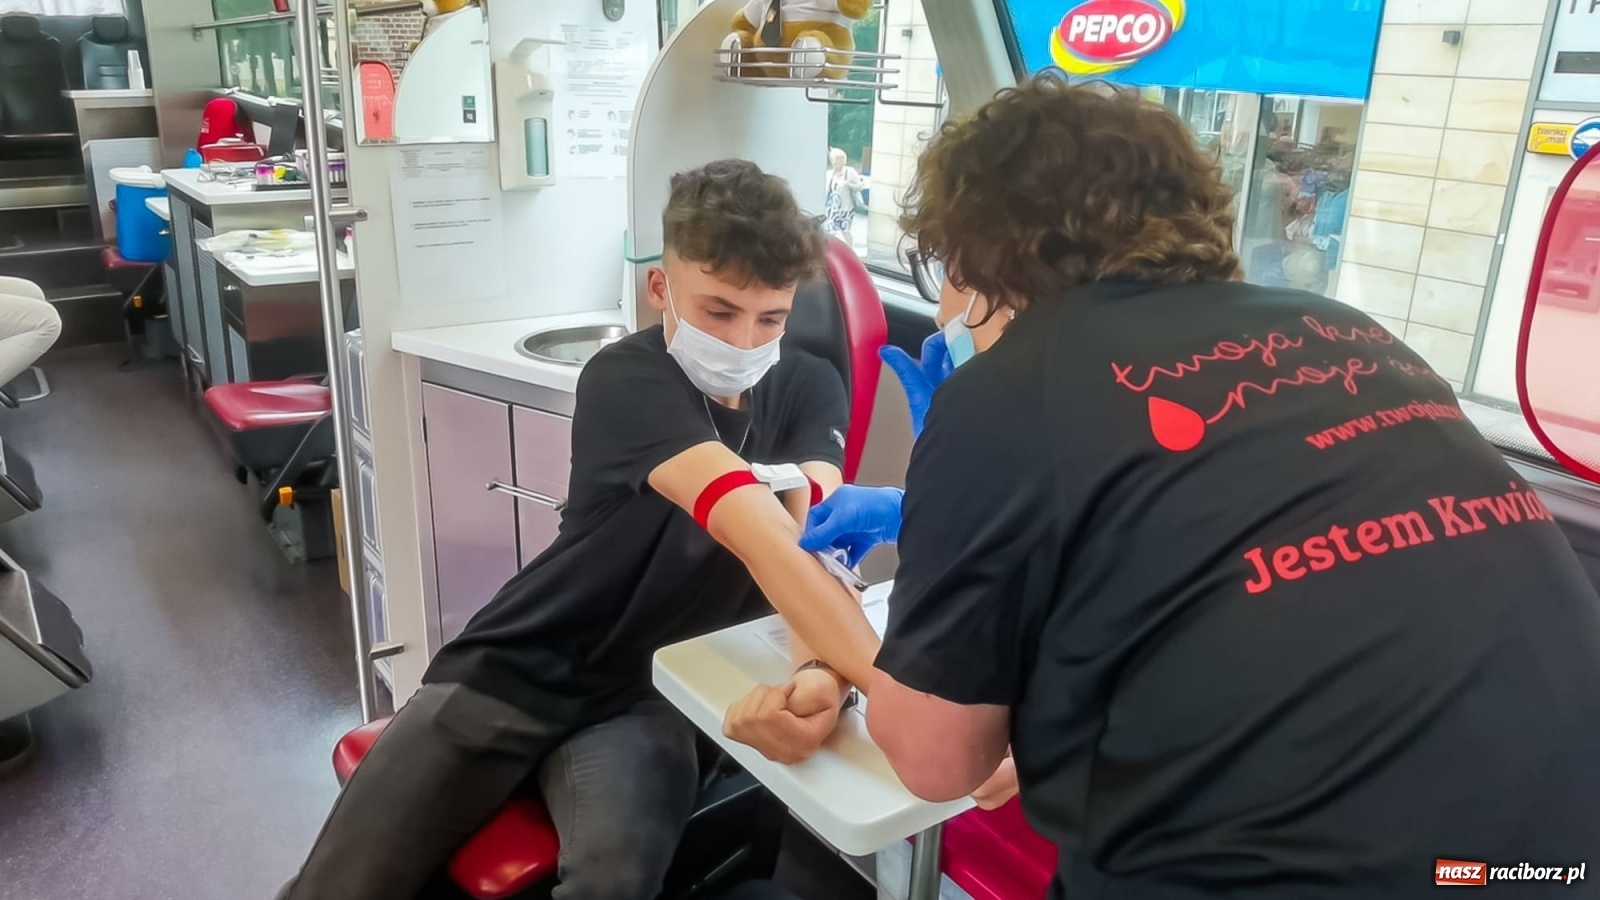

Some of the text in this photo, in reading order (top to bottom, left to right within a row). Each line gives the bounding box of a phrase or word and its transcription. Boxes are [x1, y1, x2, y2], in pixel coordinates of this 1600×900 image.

[1069, 14, 1157, 44] PEPCO
[1110, 315, 1394, 393] twoja kre
[1207, 358, 1378, 425] moje
[1243, 512, 1434, 594] Jestem
